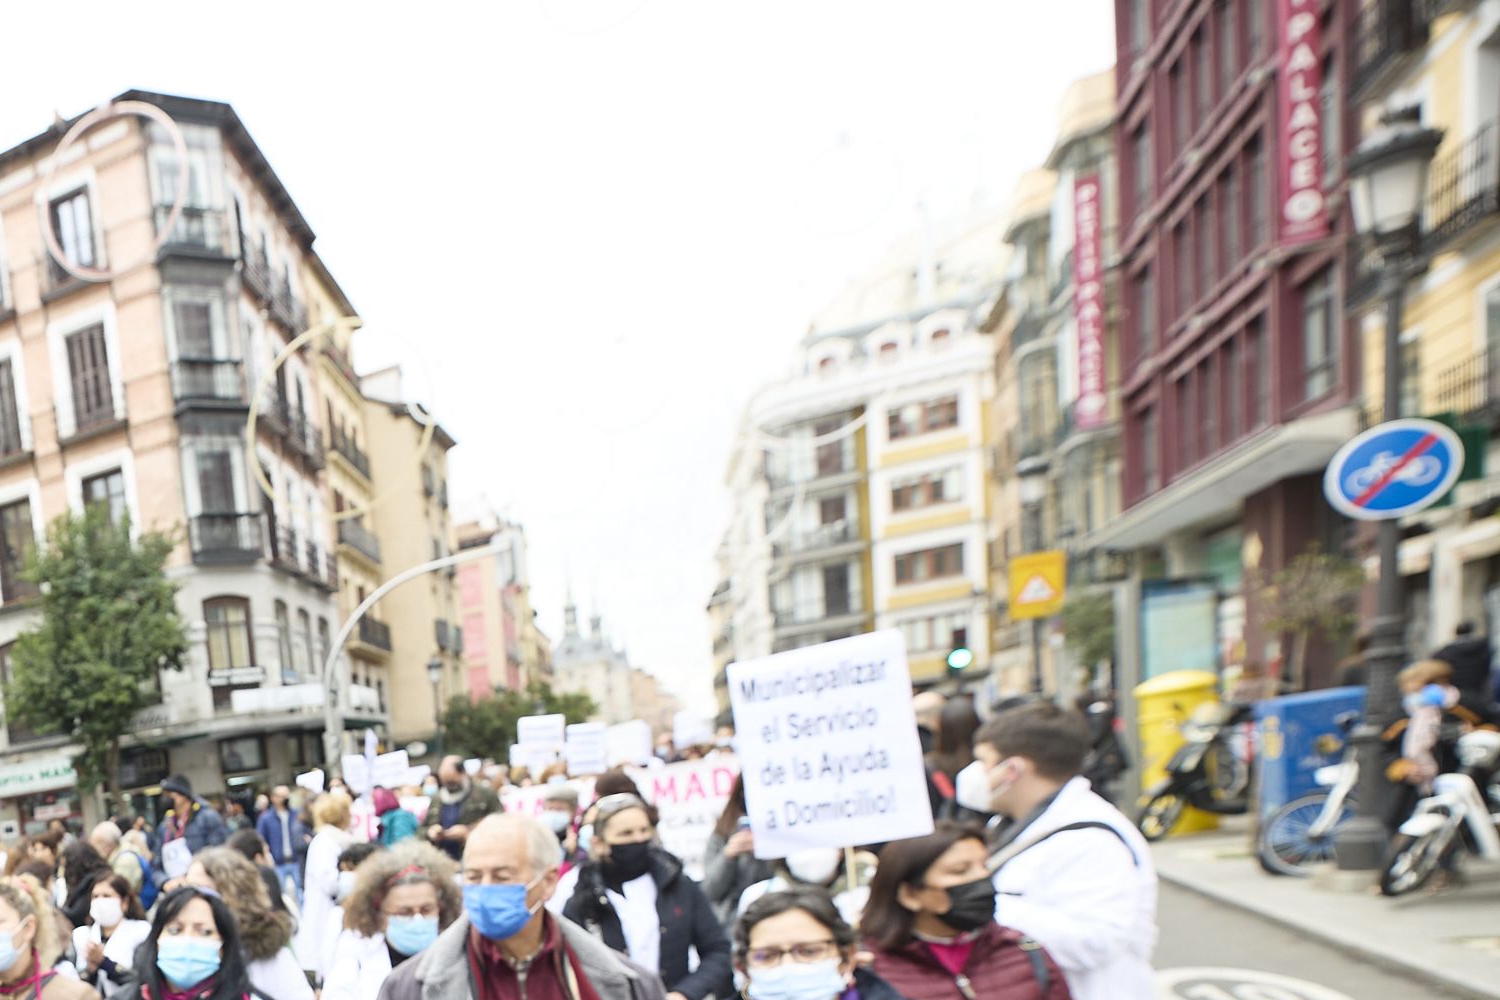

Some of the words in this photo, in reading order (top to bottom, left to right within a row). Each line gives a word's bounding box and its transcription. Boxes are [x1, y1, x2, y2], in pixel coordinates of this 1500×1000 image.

[1287, 11, 1319, 190] PALACE
[741, 661, 885, 702] Municipalizar
[761, 716, 780, 743] el
[787, 703, 878, 739] Servicio
[760, 760, 786, 786] de
[793, 755, 813, 780] la
[820, 745, 890, 783] Ayuda
[766, 809, 778, 830] a
[785, 787, 896, 826] Domicilio!
